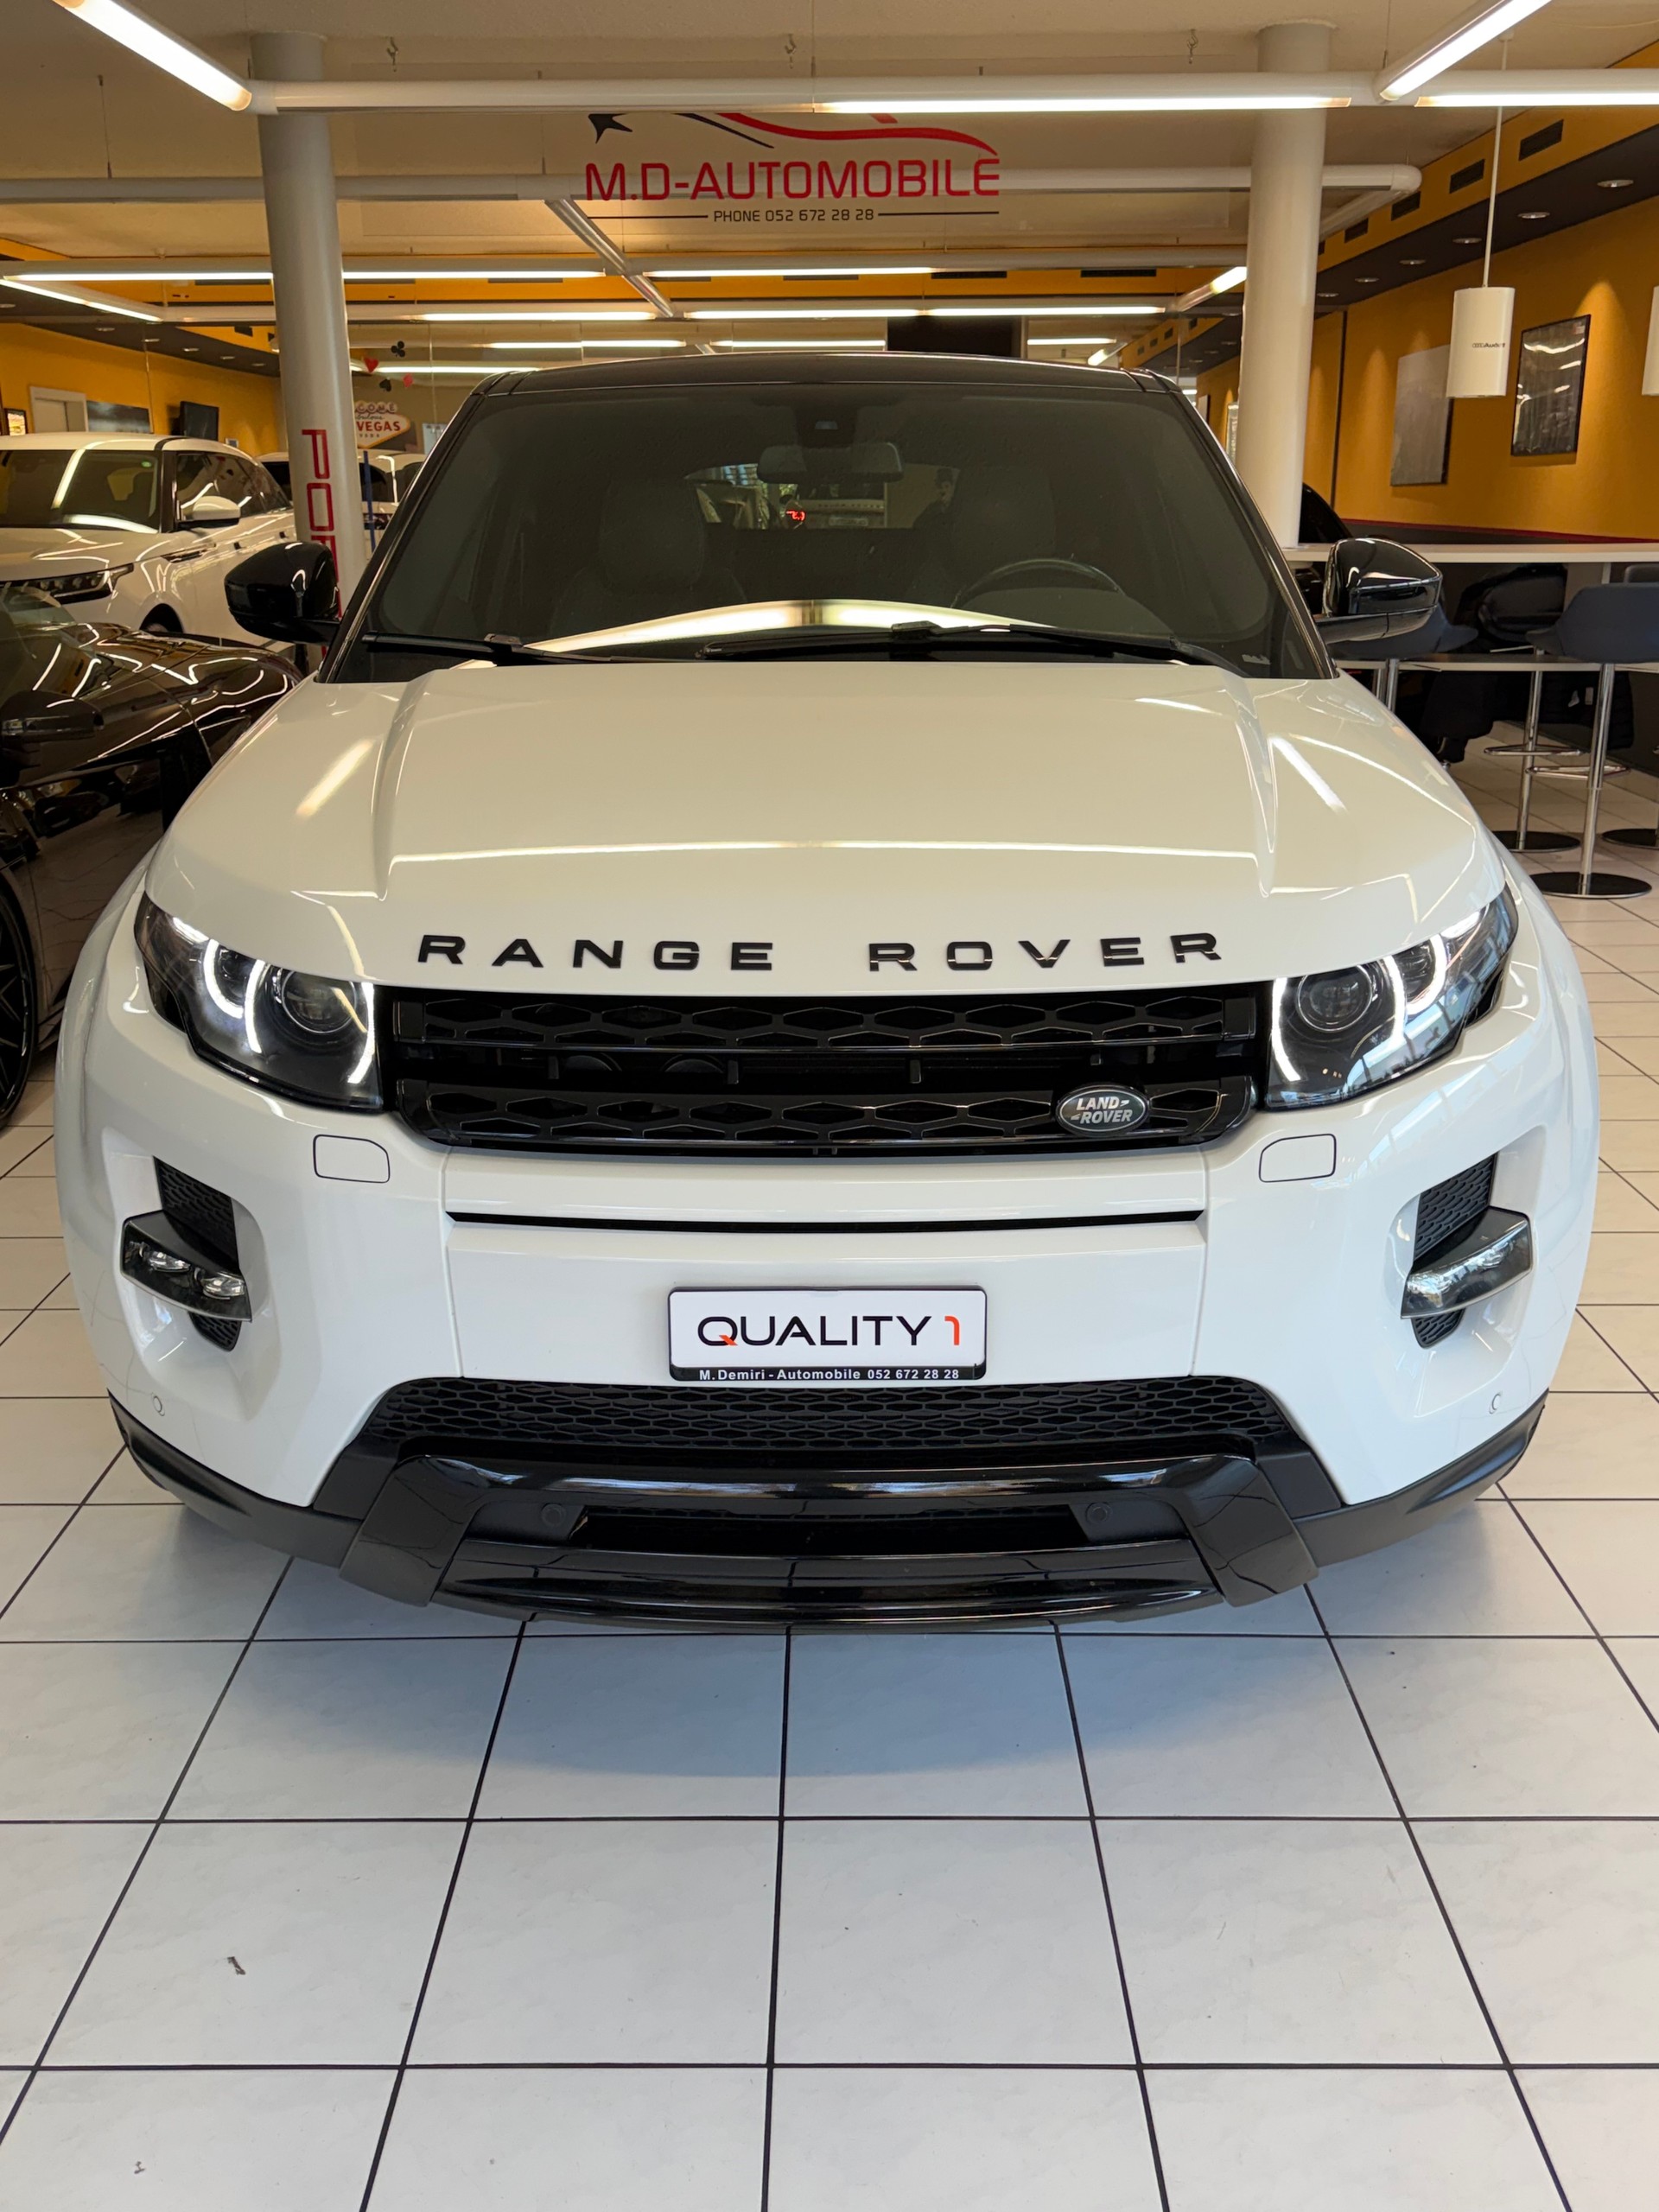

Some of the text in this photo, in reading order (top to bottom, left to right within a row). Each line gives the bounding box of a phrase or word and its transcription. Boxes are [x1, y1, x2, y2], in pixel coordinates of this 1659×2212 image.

[586, 158, 1001, 201] M.D-AUTOMOBILE
[714, 208, 874, 223] PHONE 052 672 28 28
[356, 421, 401, 432] VEGAS
[417, 932, 1222, 972] RANGE ROVER
[1076, 1096, 1120, 1111] LAND
[1079, 1109, 1133, 1124] ROVER
[697, 1315, 960, 1347] QUALITY 1
[867, 1369, 891, 1380] 052
[895, 1369, 918, 1380] 672
[924, 1369, 939, 1380] 28
[944, 1369, 959, 1380] 28
